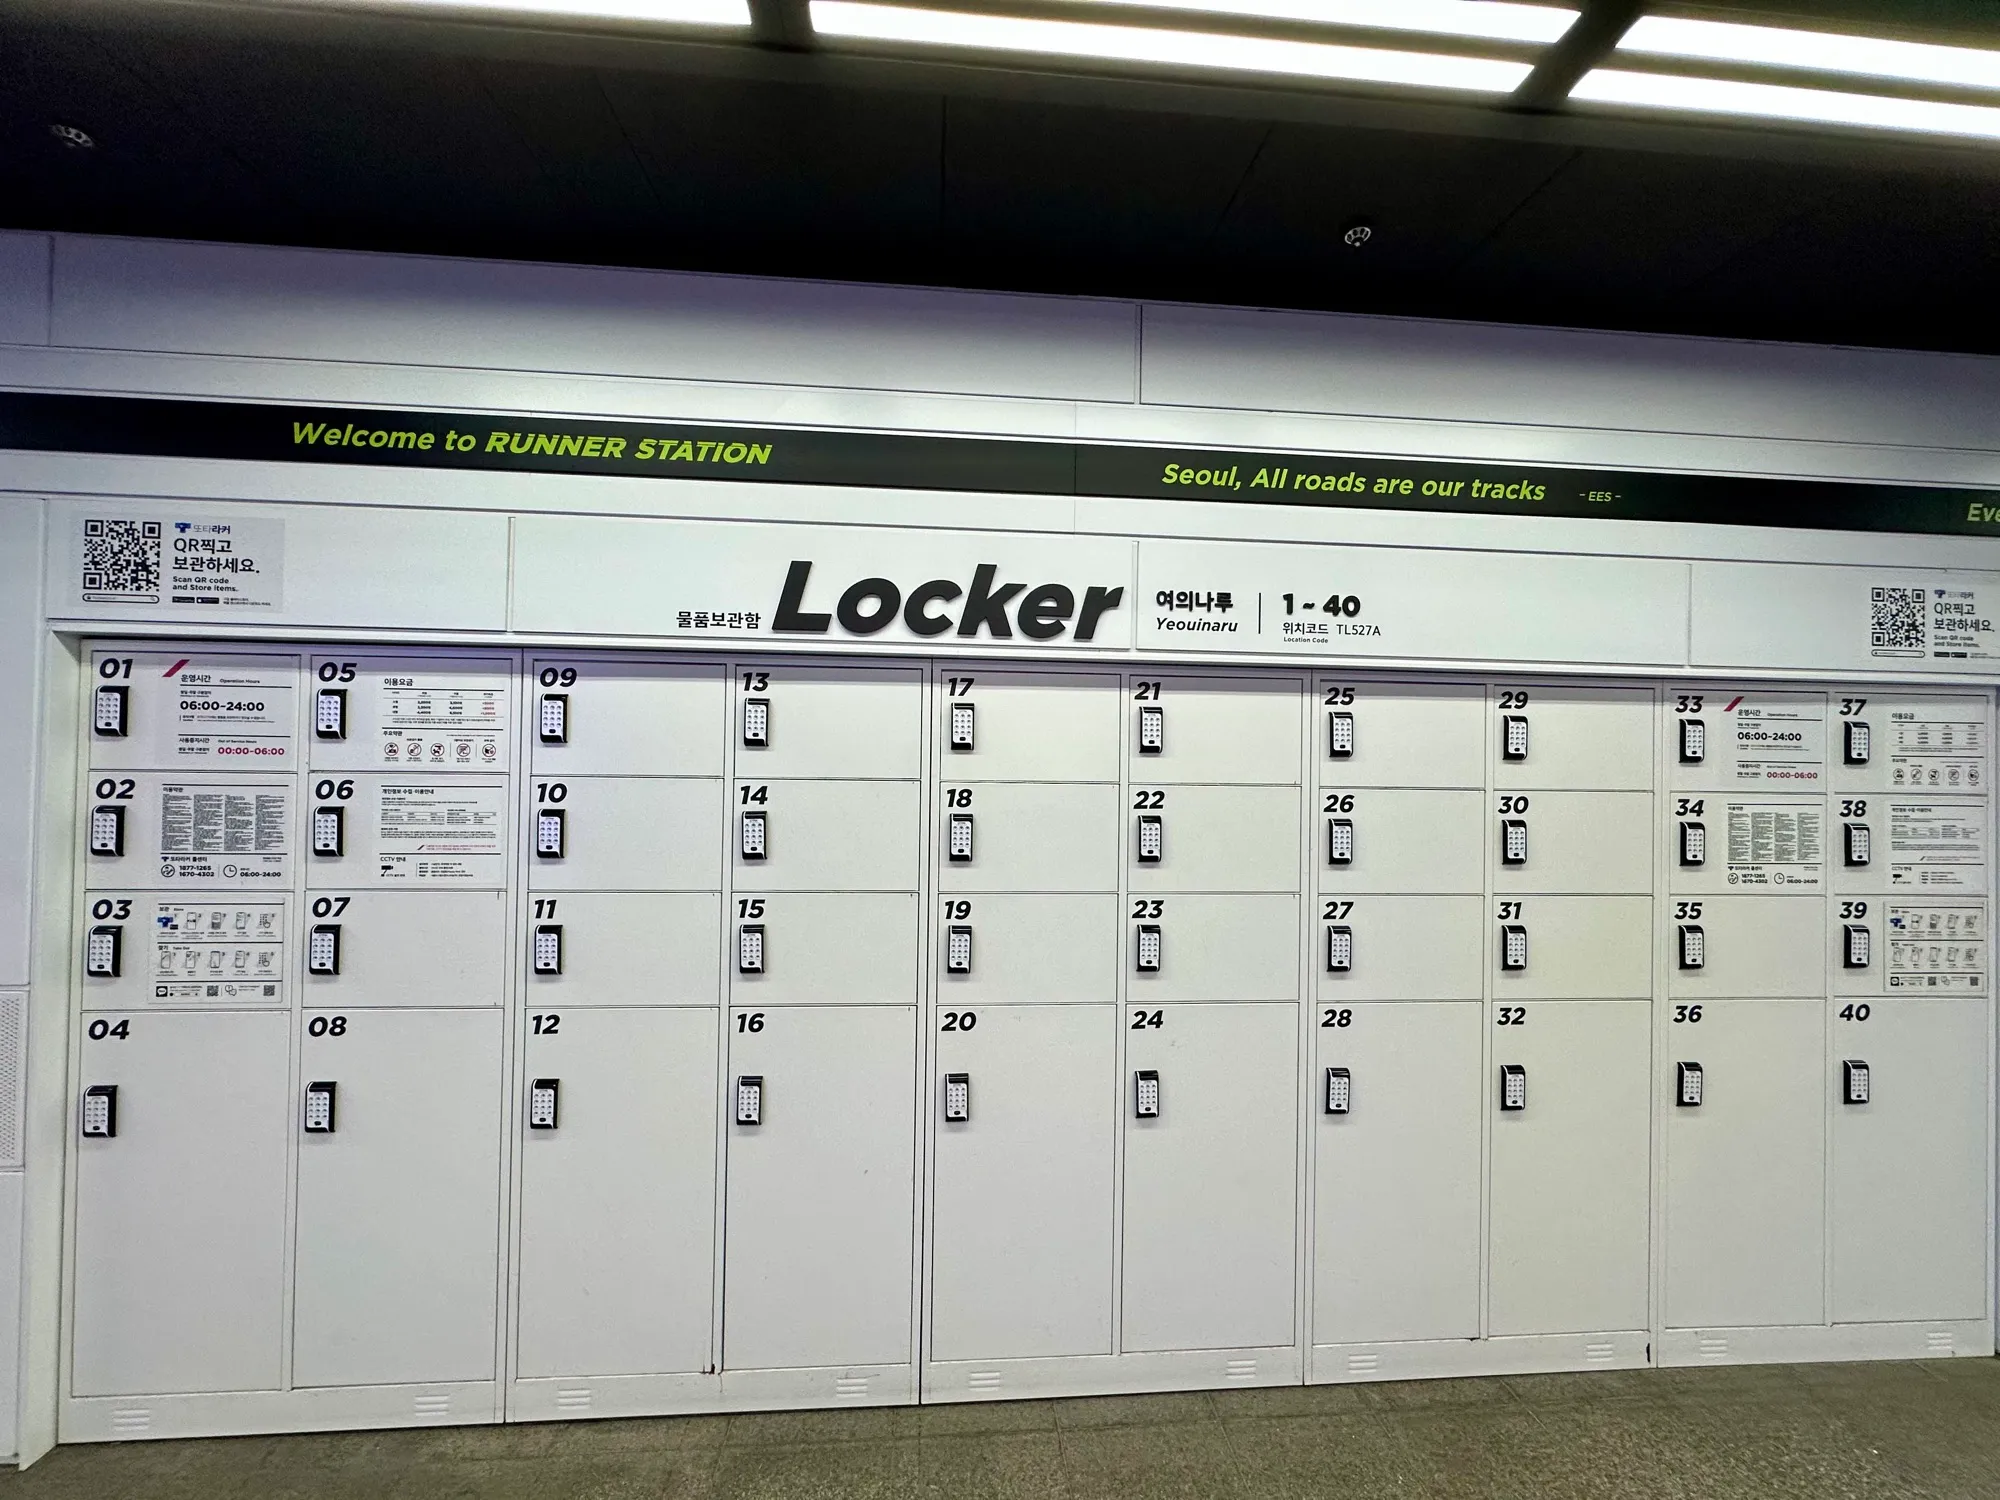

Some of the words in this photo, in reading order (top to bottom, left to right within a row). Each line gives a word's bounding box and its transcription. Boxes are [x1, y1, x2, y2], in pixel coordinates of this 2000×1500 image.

[293, 422, 435, 450] Welcome
[445, 430, 476, 451] to
[485, 431, 627, 458] RUNNER
[634, 438, 773, 465] STATION
[1161, 463, 1241, 491] Seoul,
[1250, 468, 1288, 488] All
[1293, 472, 1366, 493] roads
[1373, 478, 1413, 495] are
[1421, 479, 1464, 497] our
[1471, 479, 1546, 501] tracks
[193, 525, 231, 534] 또타라커
[174, 538, 233, 554] QR찍고
[172, 556, 260, 573] 보관하세요.
[772, 561, 1125, 640] Locker
[1156, 590, 1234, 613] 여의나루
[1282, 593, 1294, 615] 1
[1323, 595, 1361, 618] 40
[1934, 602, 1976, 617] QR찍고
[676, 611, 761, 630] 물품보관함
[1156, 617, 1239, 632] Yeouinaru
[1283, 622, 1329, 635] 위치코드
[1336, 624, 1381, 636] TL527A
[1933, 618, 1995, 633] 보관하세요.
[100, 658, 133, 678] 01
[319, 662, 357, 682] 05
[540, 667, 577, 687] 09
[181, 674, 212, 683] 운영시간
[384, 678, 413, 687] 이용요금
[743, 672, 770, 691] 13
[948, 678, 974, 696] 17
[1135, 682, 1161, 700] 21
[1325, 687, 1355, 705] 25
[1499, 691, 1529, 709] 29
[1675, 695, 1704, 713] 33
[1839, 698, 1867, 715] 37
[96, 779, 135, 799] 02
[316, 780, 354, 799] 06
[538, 783, 567, 803] 10
[741, 786, 767, 804] 14
[947, 789, 972, 807] 18
[1134, 791, 1164, 809] 22
[1324, 795, 1354, 812] 26
[1498, 796, 1528, 814] 30
[1675, 799, 1704, 816] 34
[1839, 800, 1866, 817] 38
[93, 899, 132, 920] 03
[313, 897, 350, 917] 07
[535, 900, 556, 919] 11
[739, 899, 765, 918] 15
[945, 901, 971, 919] 19
[1132, 900, 1164, 918] 23
[1323, 902, 1354, 919] 27
[1497, 902, 1521, 919] 31
[1674, 902, 1702, 919] 35
[1839, 902, 1867, 919] 39
[941, 1012, 976, 1031] 20
[1131, 1010, 1163, 1029] 24
[1322, 1009, 1352, 1027] 28
[1497, 1007, 1525, 1025] 32
[1673, 1005, 1702, 1023] 36
[1840, 1004, 1870, 1021] 40
[89, 1020, 129, 1040] 04
[309, 1016, 347, 1037] 08
[533, 1015, 560, 1034] 12
[738, 1013, 764, 1033] 16
